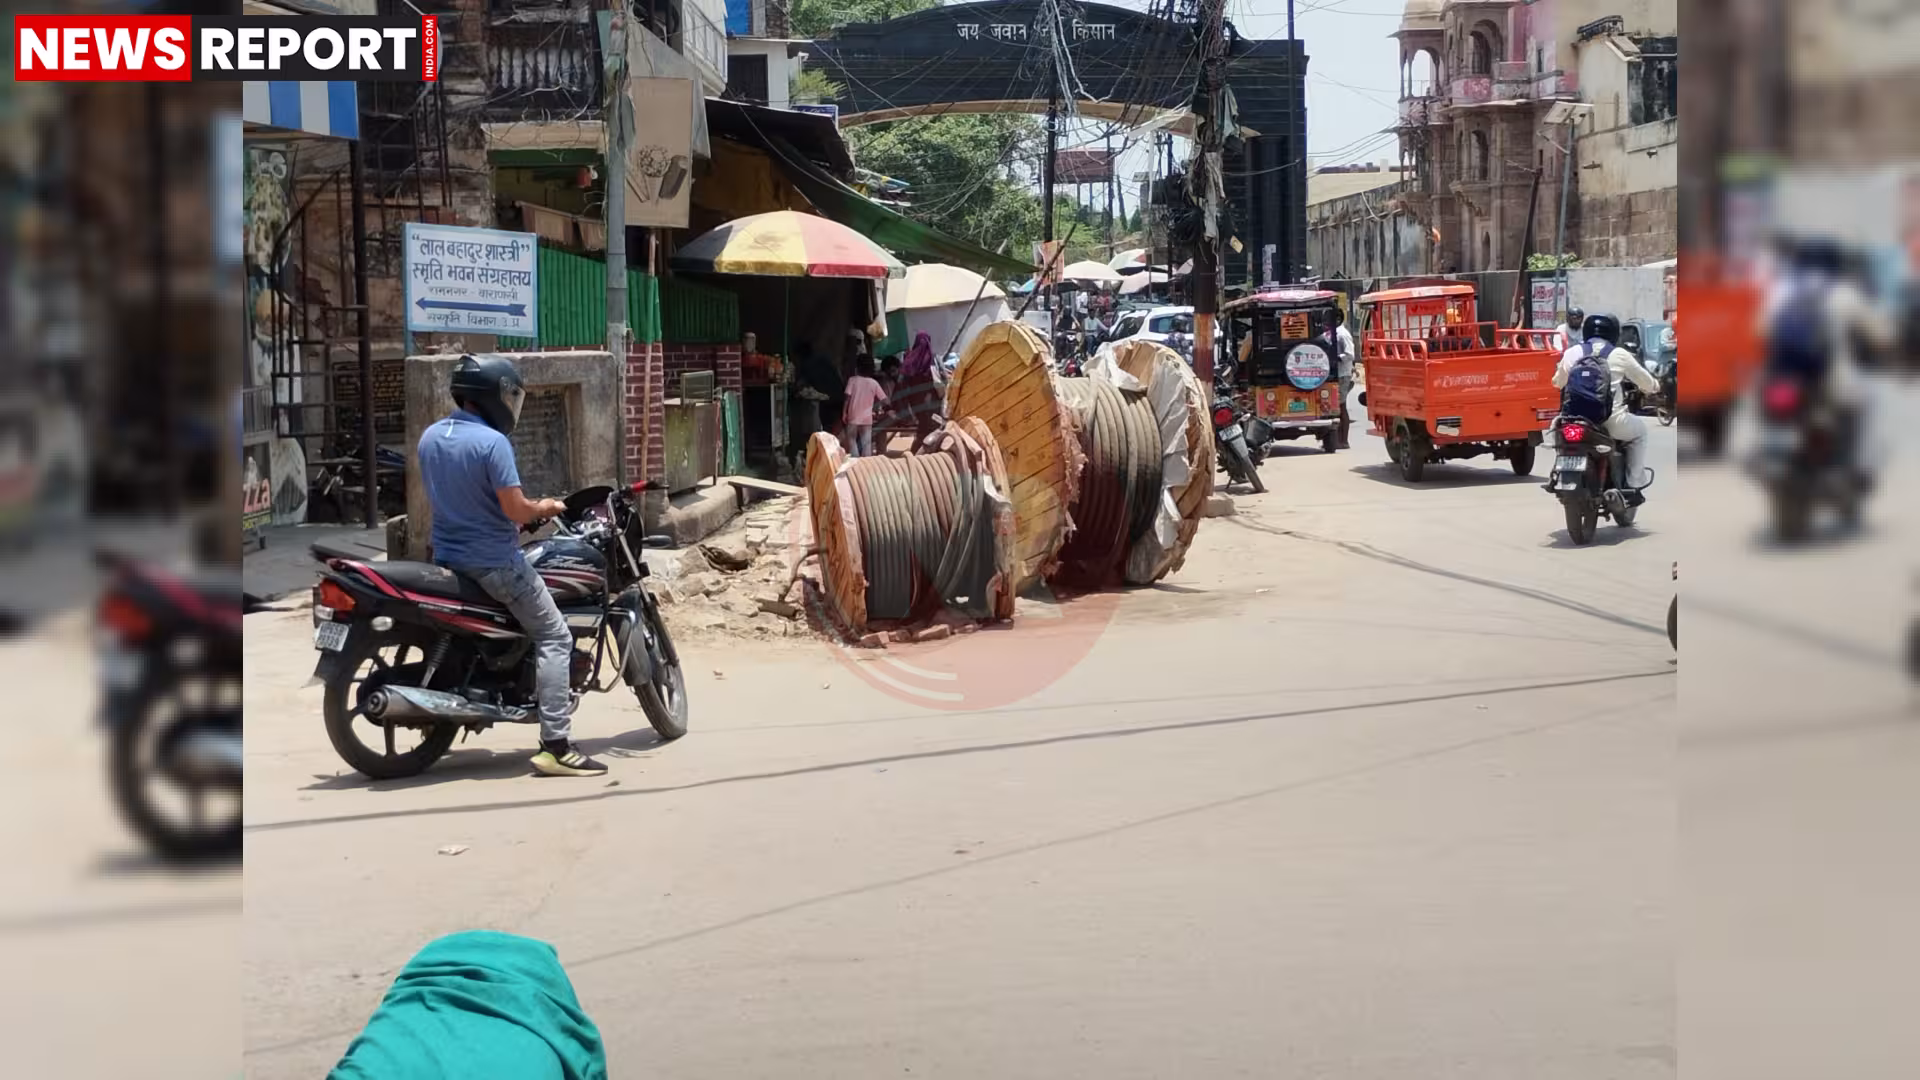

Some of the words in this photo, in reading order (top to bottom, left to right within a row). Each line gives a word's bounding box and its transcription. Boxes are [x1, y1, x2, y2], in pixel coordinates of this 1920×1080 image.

[956, 23, 980, 40] जय
[1072, 18, 1116, 40] किसान
[446, 240, 483, 263] बहादुर
[412, 257, 443, 284] स्मृति
[447, 264, 475, 283] भवन
[477, 261, 532, 288] संग्रहालय
